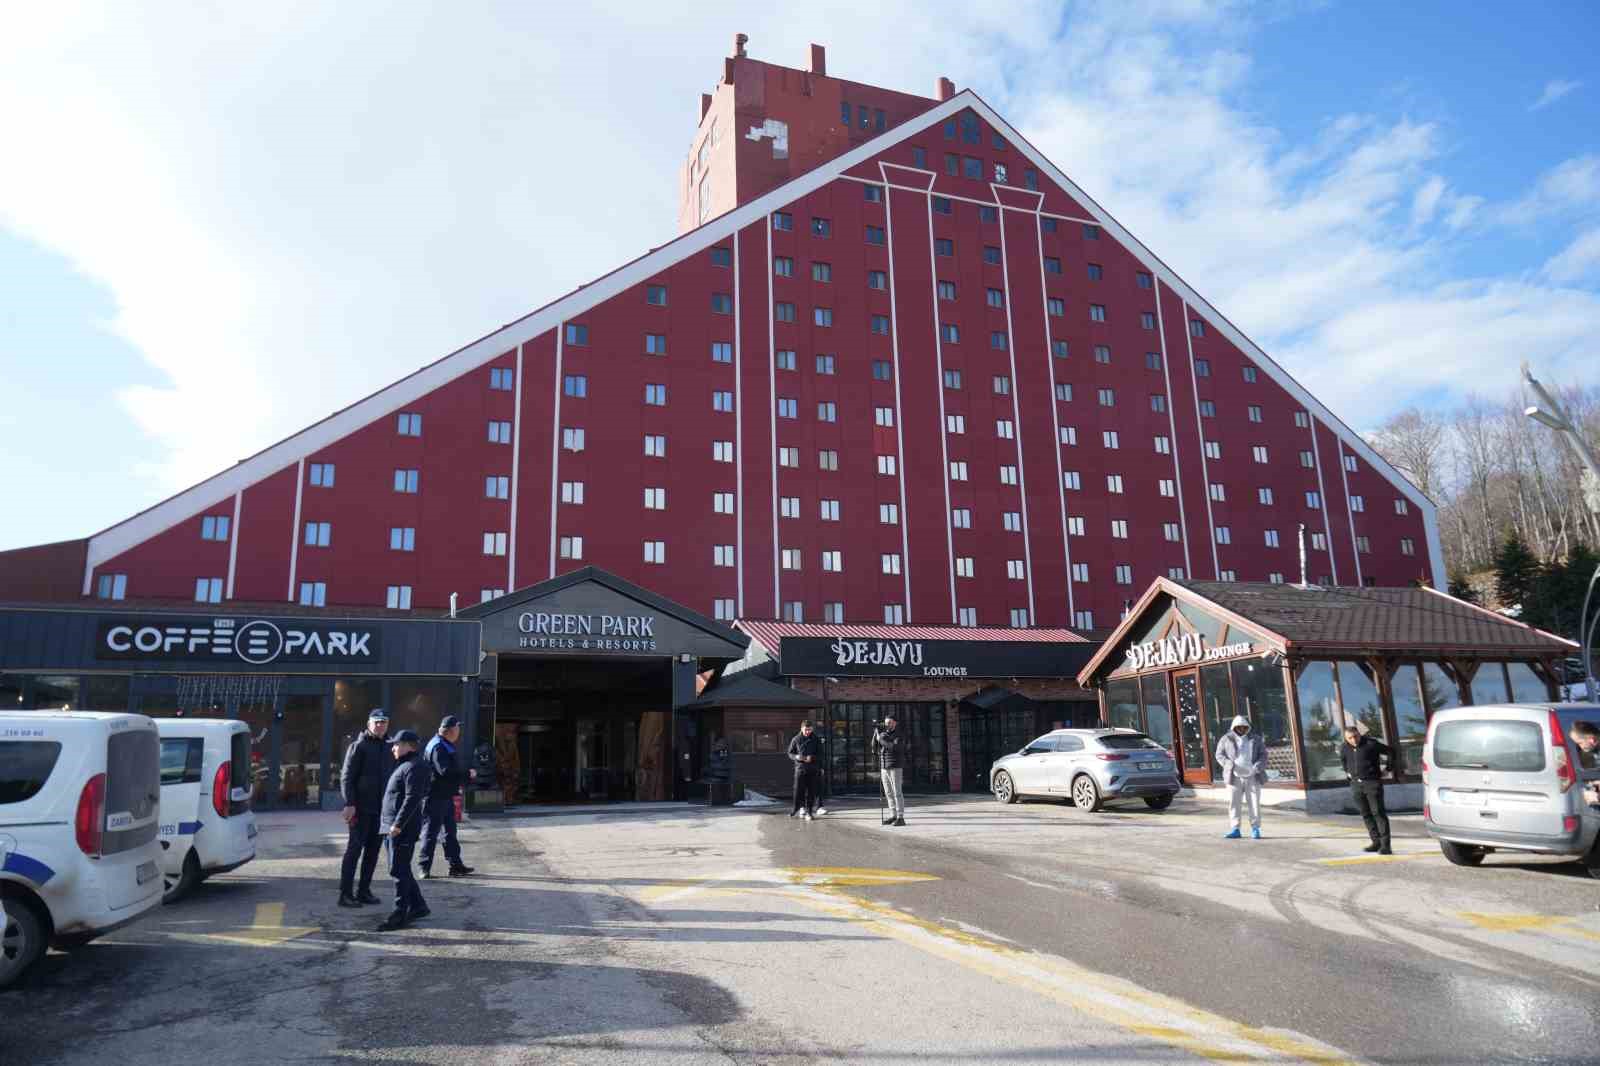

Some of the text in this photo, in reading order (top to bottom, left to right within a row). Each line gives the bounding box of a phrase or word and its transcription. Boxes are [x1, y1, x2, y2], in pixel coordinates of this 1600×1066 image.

[518, 612, 655, 639] GREEN PARK
[285, 630, 371, 656] PARK
[519, 637, 657, 650] HOTELS & RESORTS
[1205, 642, 1250, 660] LOUNGE
[923, 666, 968, 676] LOUNGE
